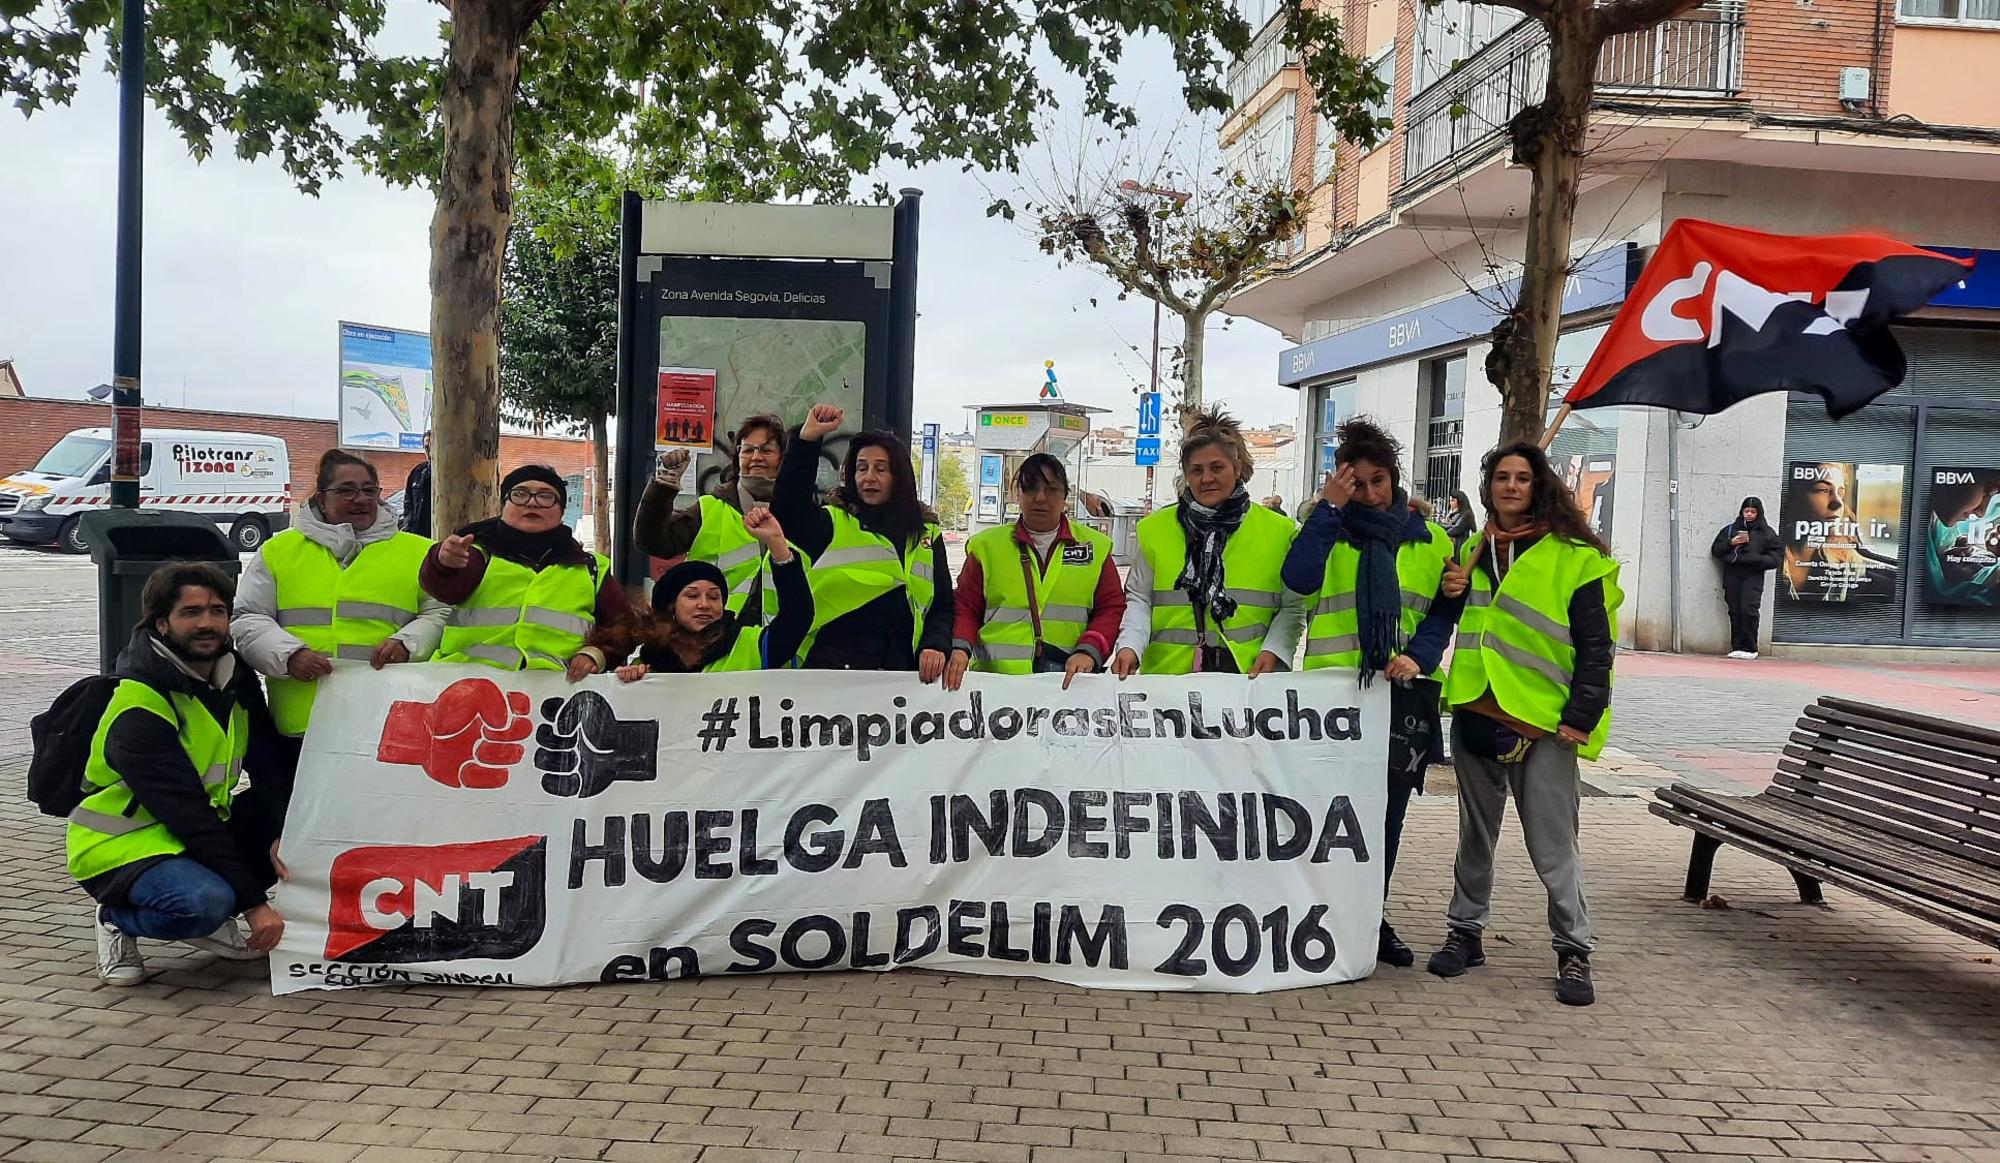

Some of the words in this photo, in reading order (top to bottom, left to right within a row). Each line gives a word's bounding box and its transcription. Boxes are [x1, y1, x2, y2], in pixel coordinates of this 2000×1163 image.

[661, 288, 688, 300] Zona
[690, 289, 733, 302] Avenida
[735, 290, 781, 304] Segovia,
[783, 291, 826, 304] Delicias
[1389, 316, 1422, 348] BBVA
[1292, 348, 1316, 373] BBVA
[994, 415, 1025, 425] ONCE
[173, 444, 254, 461] Pilotrans
[1136, 447, 1160, 456] TAXI
[1794, 467, 1832, 480] BBVA
[1936, 472, 1975, 484] BBVA
[1064, 549, 1083, 557] CNT
[1947, 555, 1961, 563] Hoy
[697, 689, 1362, 762] #LimpiadorasEnLucha
[567, 798, 907, 890] HUELGA
[929, 787, 1370, 864] INDEFINIDA
[360, 869, 515, 930] CNT
[599, 945, 701, 984] en
[728, 900, 1128, 975] SOLDELIM
[1154, 903, 1336, 977] 2016
